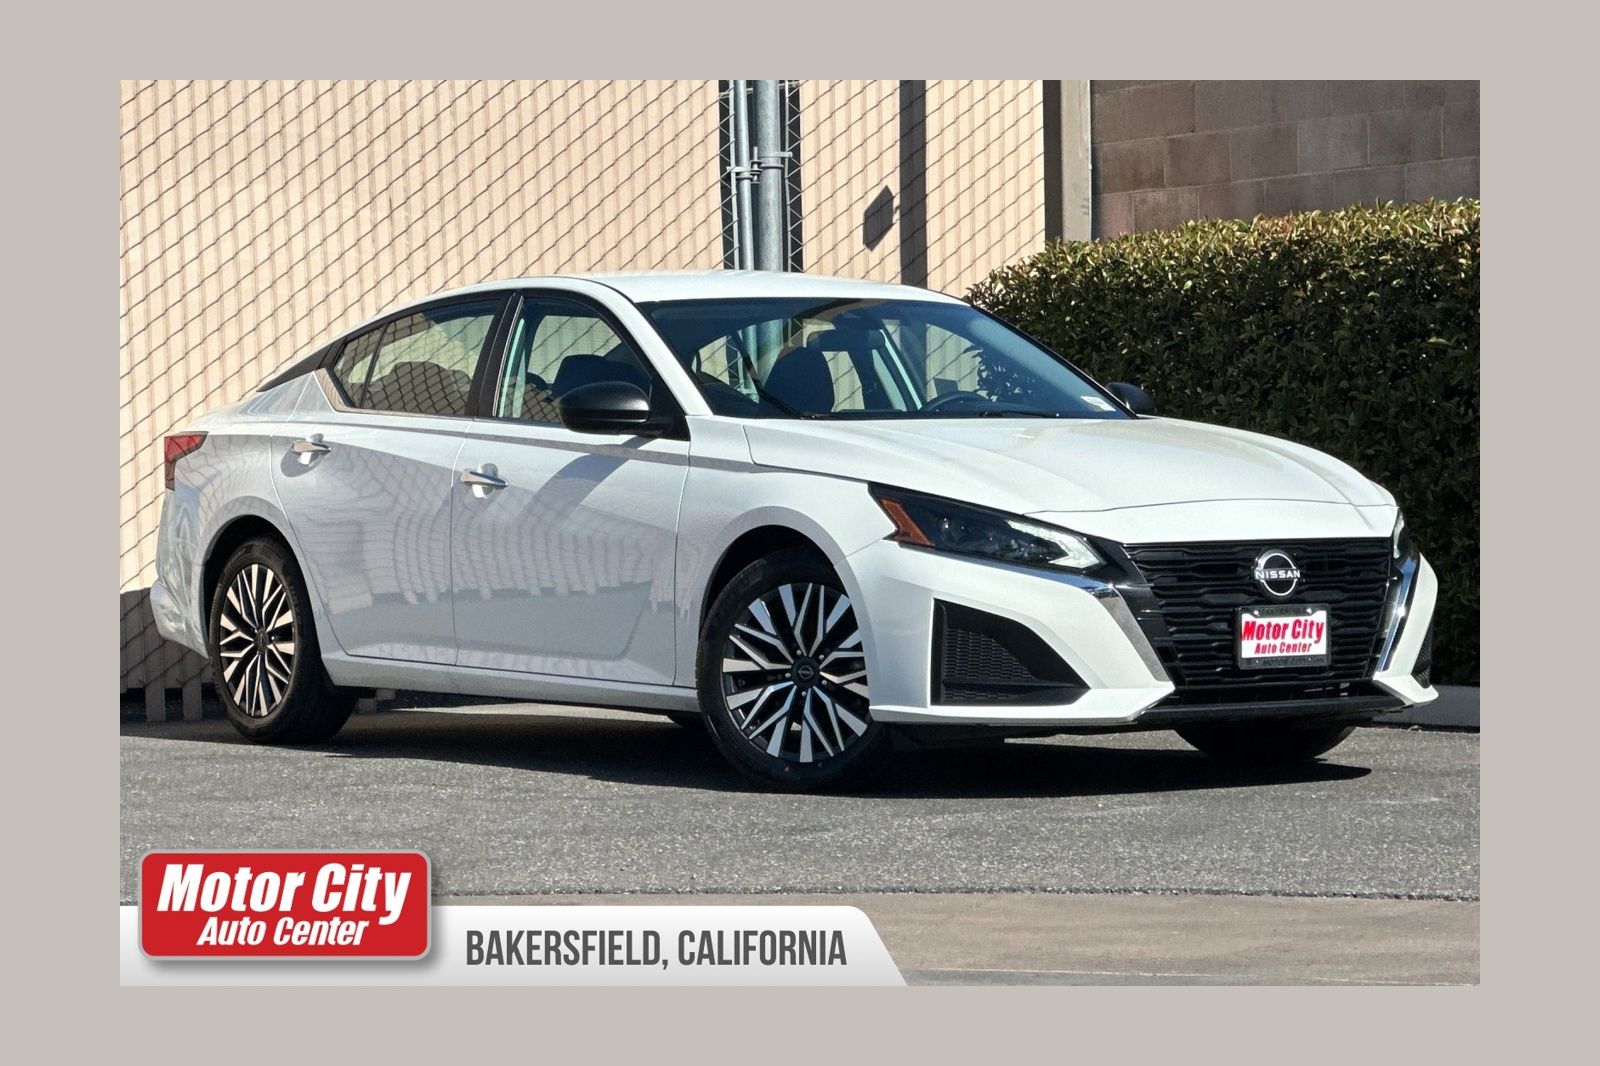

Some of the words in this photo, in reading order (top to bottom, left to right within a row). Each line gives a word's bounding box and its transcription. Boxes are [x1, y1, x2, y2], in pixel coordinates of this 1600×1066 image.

[1255, 570, 1301, 579] NISSAN
[1241, 620, 1289, 640] Motor
[1291, 619, 1325, 644] City
[1254, 643, 1277, 654] Auto
[1279, 642, 1312, 653] Center
